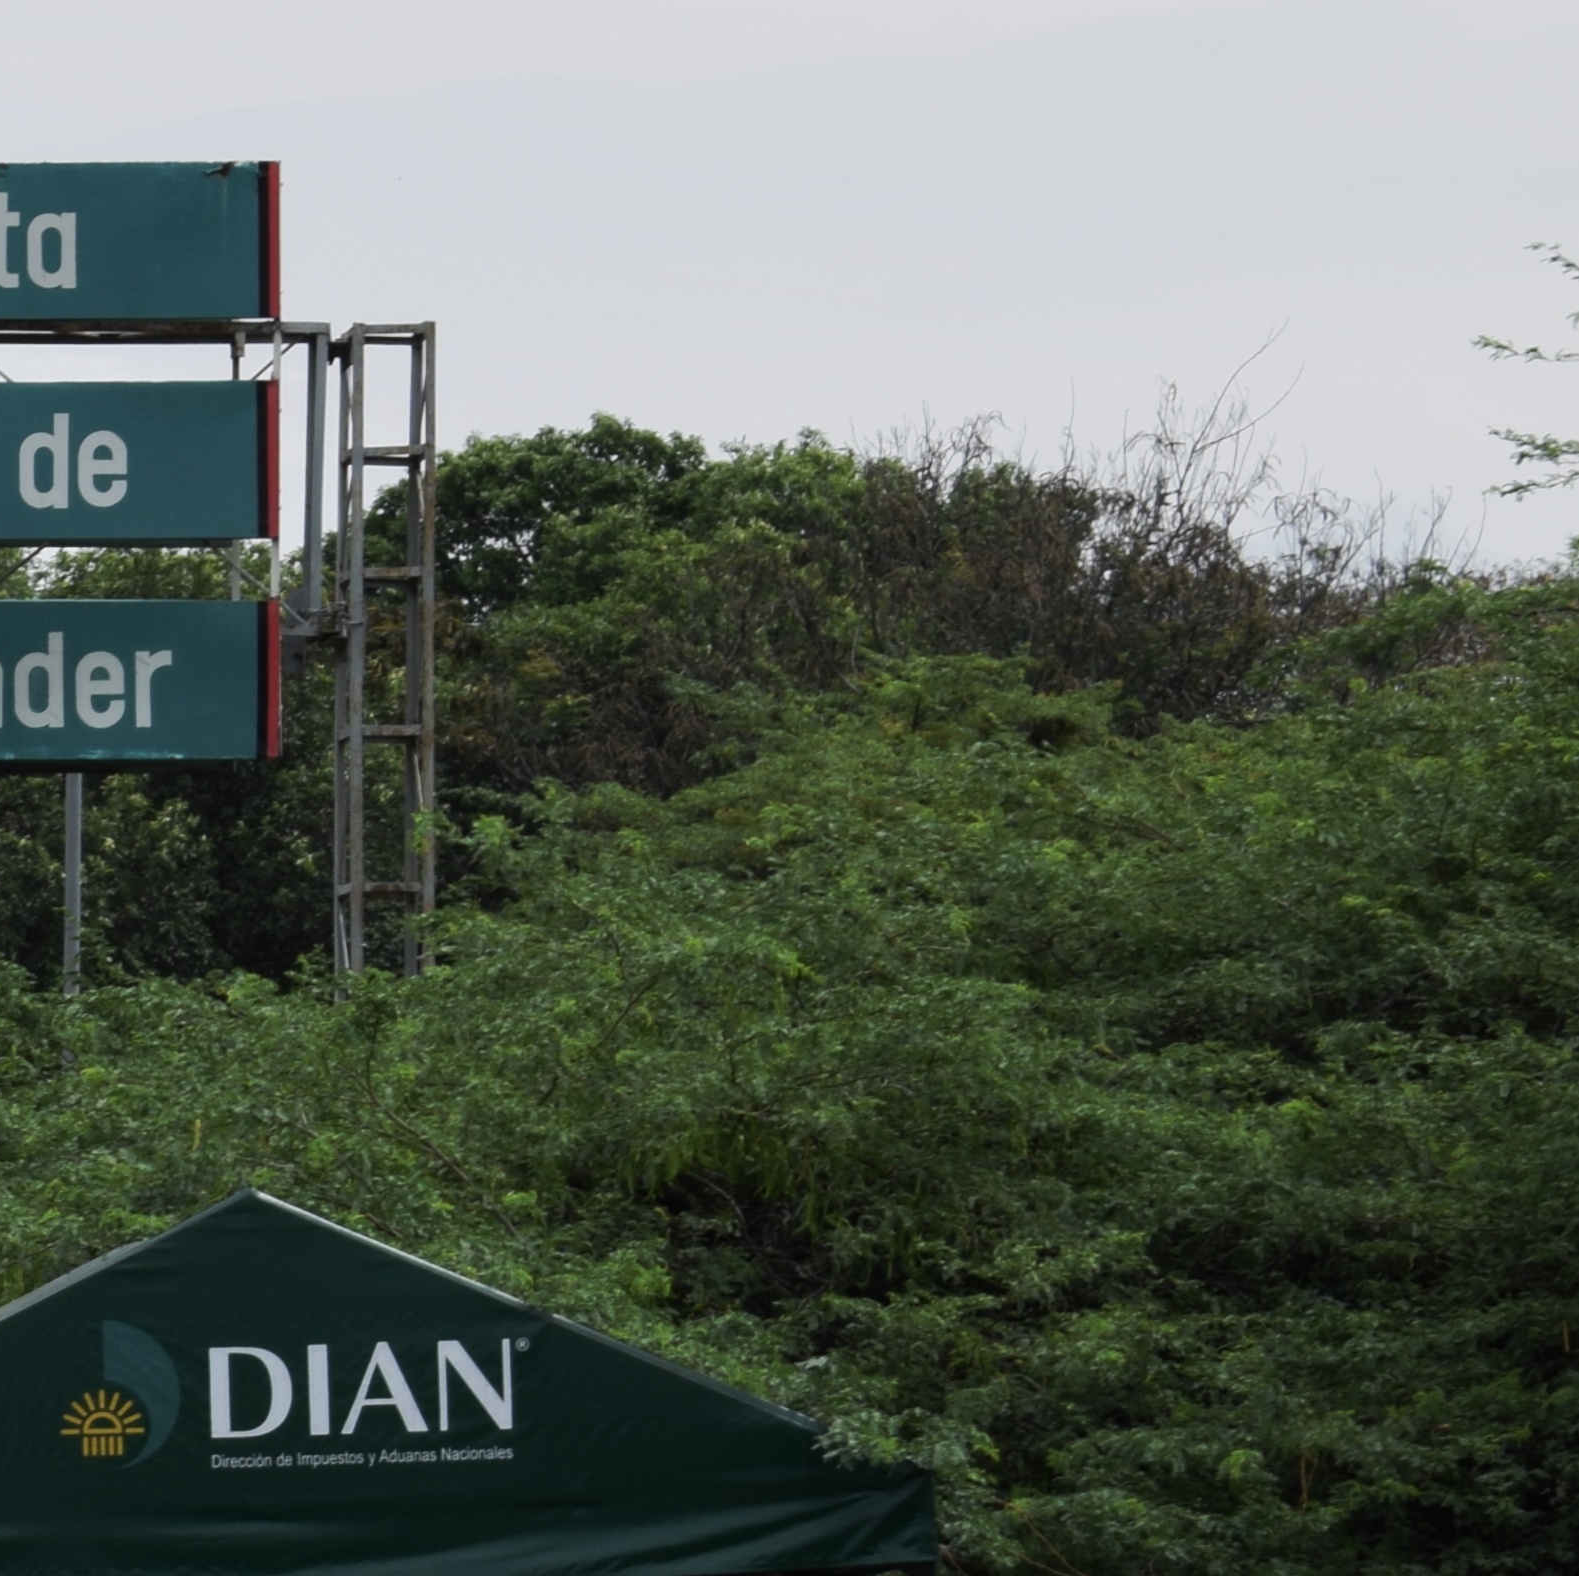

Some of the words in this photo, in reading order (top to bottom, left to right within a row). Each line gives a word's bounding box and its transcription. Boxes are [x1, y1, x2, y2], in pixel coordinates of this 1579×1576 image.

[17, 411, 129, 510] de
[207, 1337, 515, 1439] DIAN
[211, 1452, 272, 1468] Dirección
[276, 1452, 293, 1467] de
[297, 1451, 365, 1469] Impuestos
[367, 1453, 376, 1467] y
[379, 1449, 437, 1464] Aduanas
[440, 1445, 515, 1461] Nacionales
